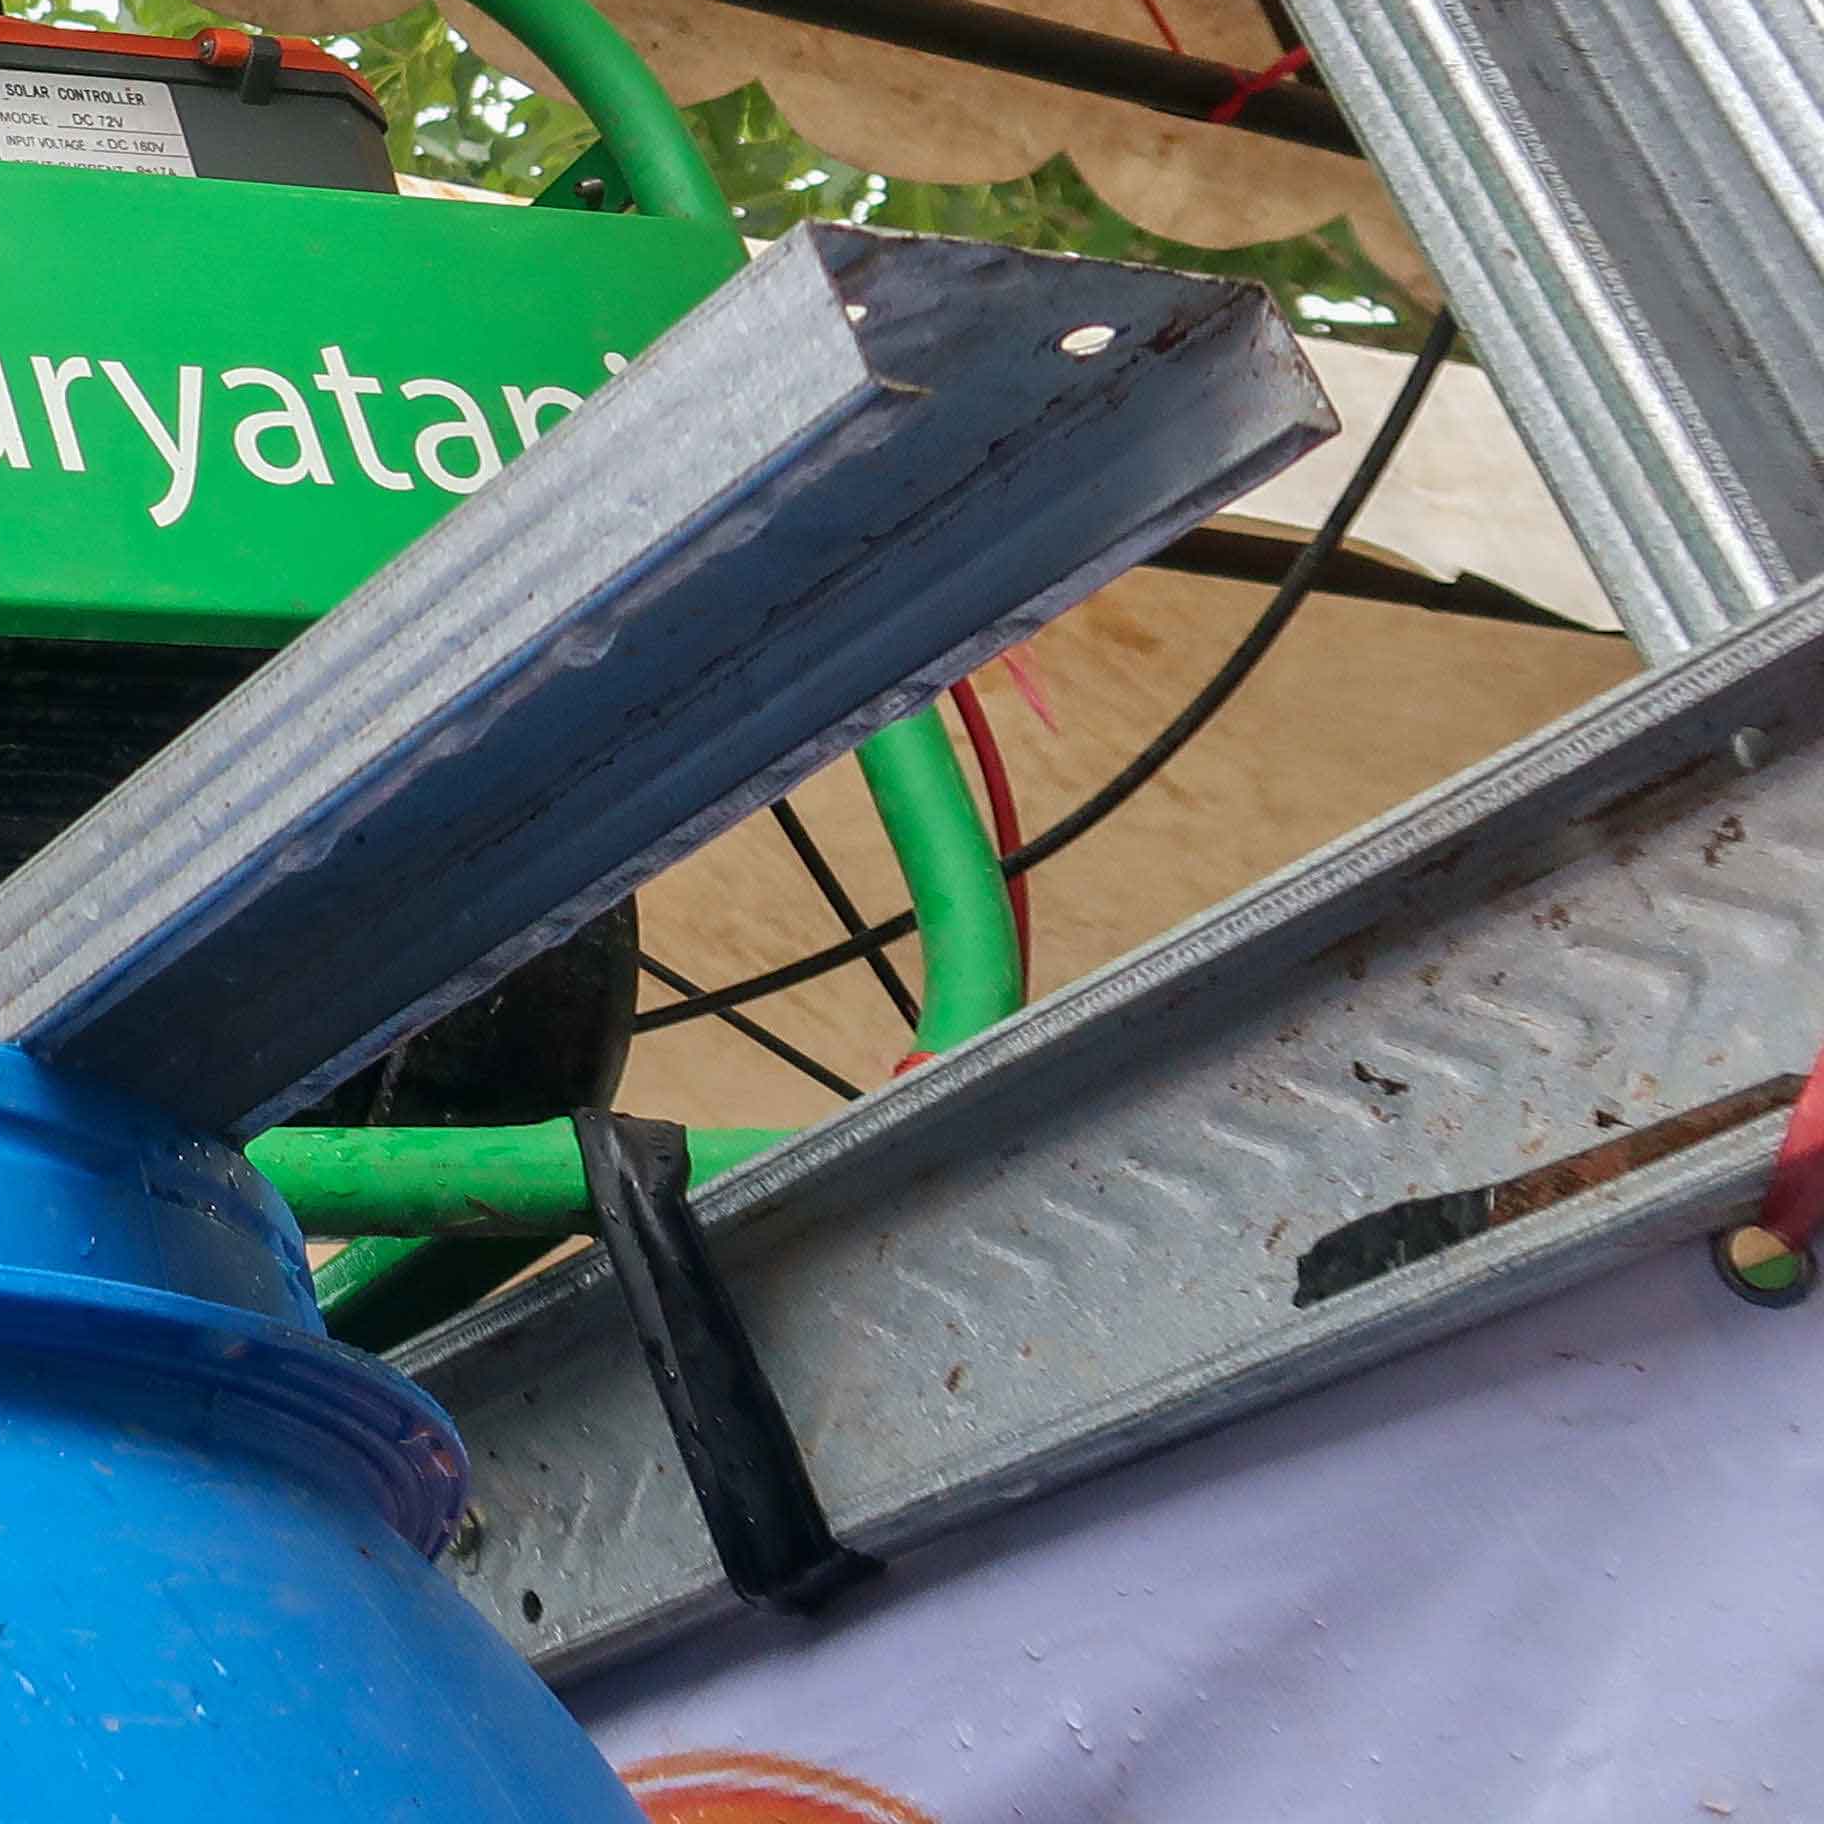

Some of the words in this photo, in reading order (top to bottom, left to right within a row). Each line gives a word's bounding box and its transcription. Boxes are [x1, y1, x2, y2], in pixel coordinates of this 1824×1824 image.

[4, 83, 50, 99] SOLAR
[57, 88, 145, 106] CONTROLLER
[72, 113, 94, 127] DC
[98, 115, 124, 128] 72V
[6, 135, 37, 148] INPUT
[107, 138, 129, 151] DC
